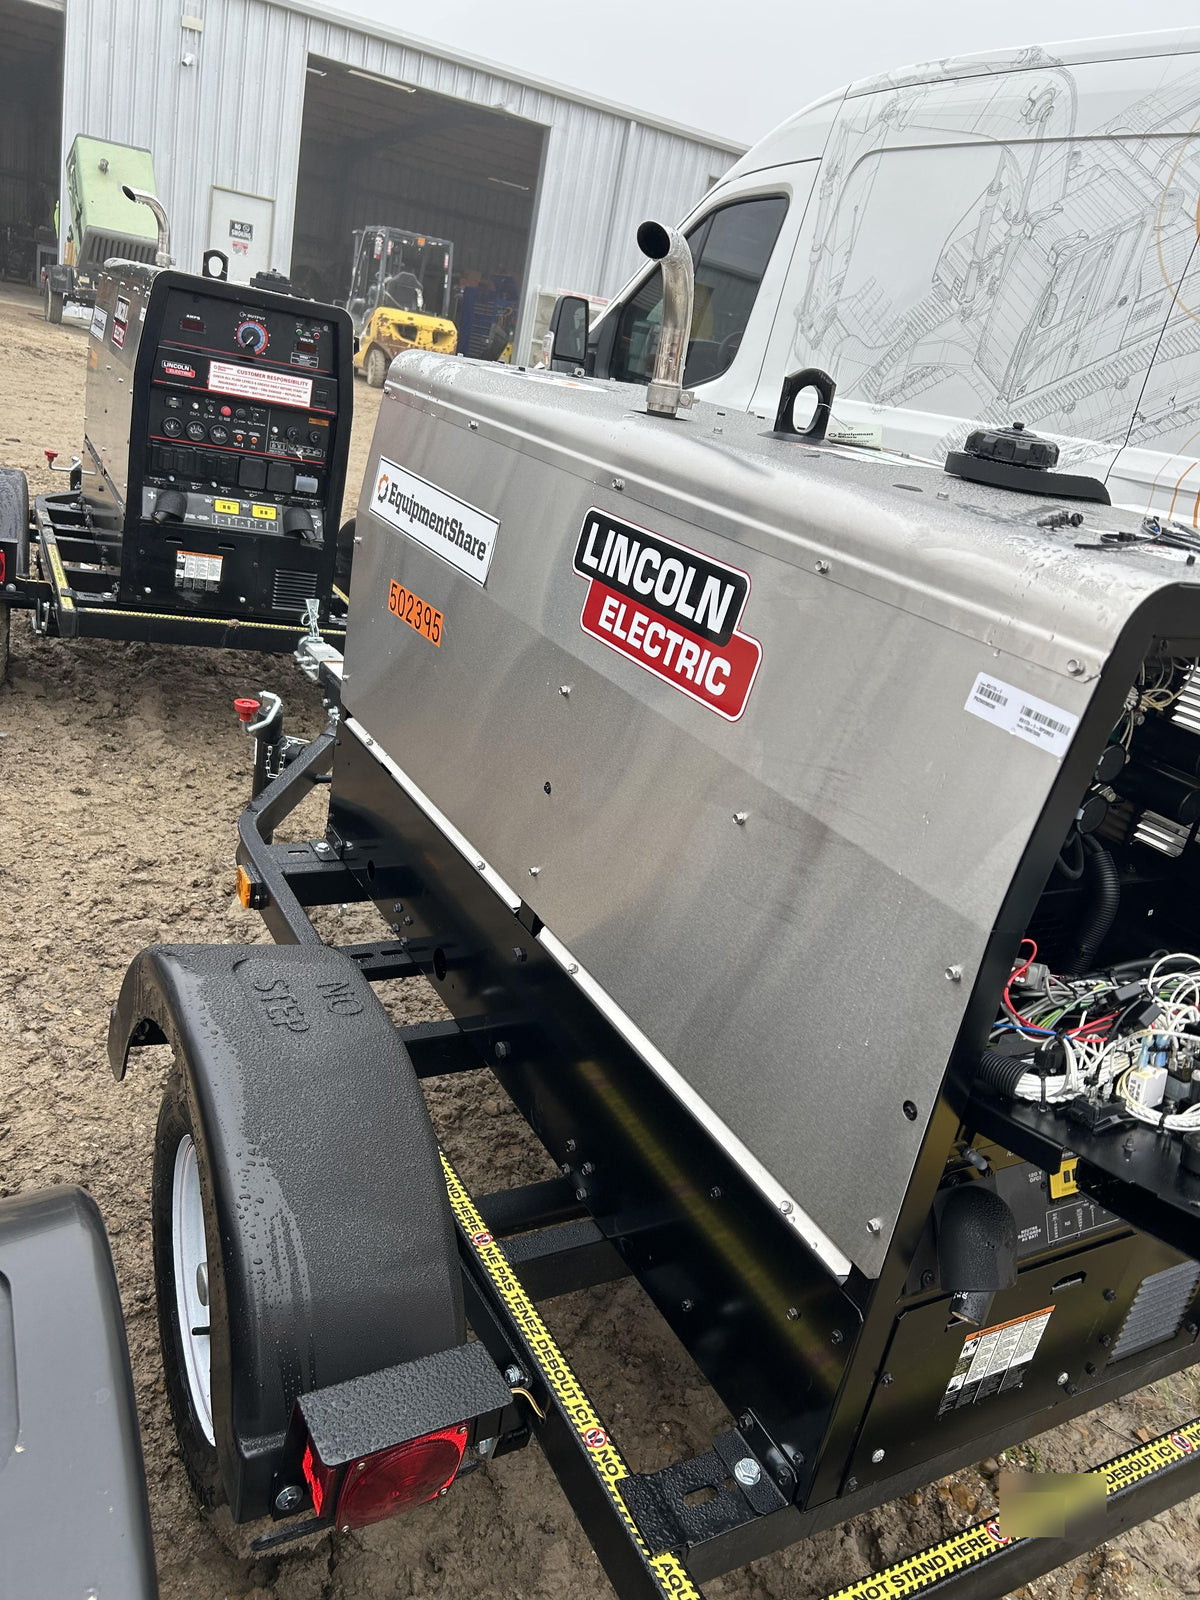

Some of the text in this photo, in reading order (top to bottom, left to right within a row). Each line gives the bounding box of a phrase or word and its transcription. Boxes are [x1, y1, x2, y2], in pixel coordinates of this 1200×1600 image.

[163, 361, 190, 371] LINCOLN
[236, 369, 308, 386] CUSTOMER RESPONSIBILITY
[388, 482, 488, 562] EquipmentShare
[582, 522, 735, 634] LINCOLN
[390, 584, 442, 643] 502395
[598, 595, 731, 696] ELECTRIC
[254, 980, 310, 1032] STEP
[317, 982, 364, 1016] NO
[444, 1169, 461, 1199] TAND
[457, 1200, 481, 1232] HERE
[483, 1247, 500, 1264] NE
[494, 1266, 515, 1292] PAS
[511, 1296, 542, 1338] TENEZ
[536, 1339, 580, 1400] DEBOUT
[572, 1403, 593, 1426] ICI
[598, 1449, 619, 1476] NO
[1106, 1452, 1157, 1485] DEBOUT
[1155, 1443, 1176, 1459] ICI
[890, 1555, 947, 1589] STAND
[947, 1533, 992, 1561] HERE
